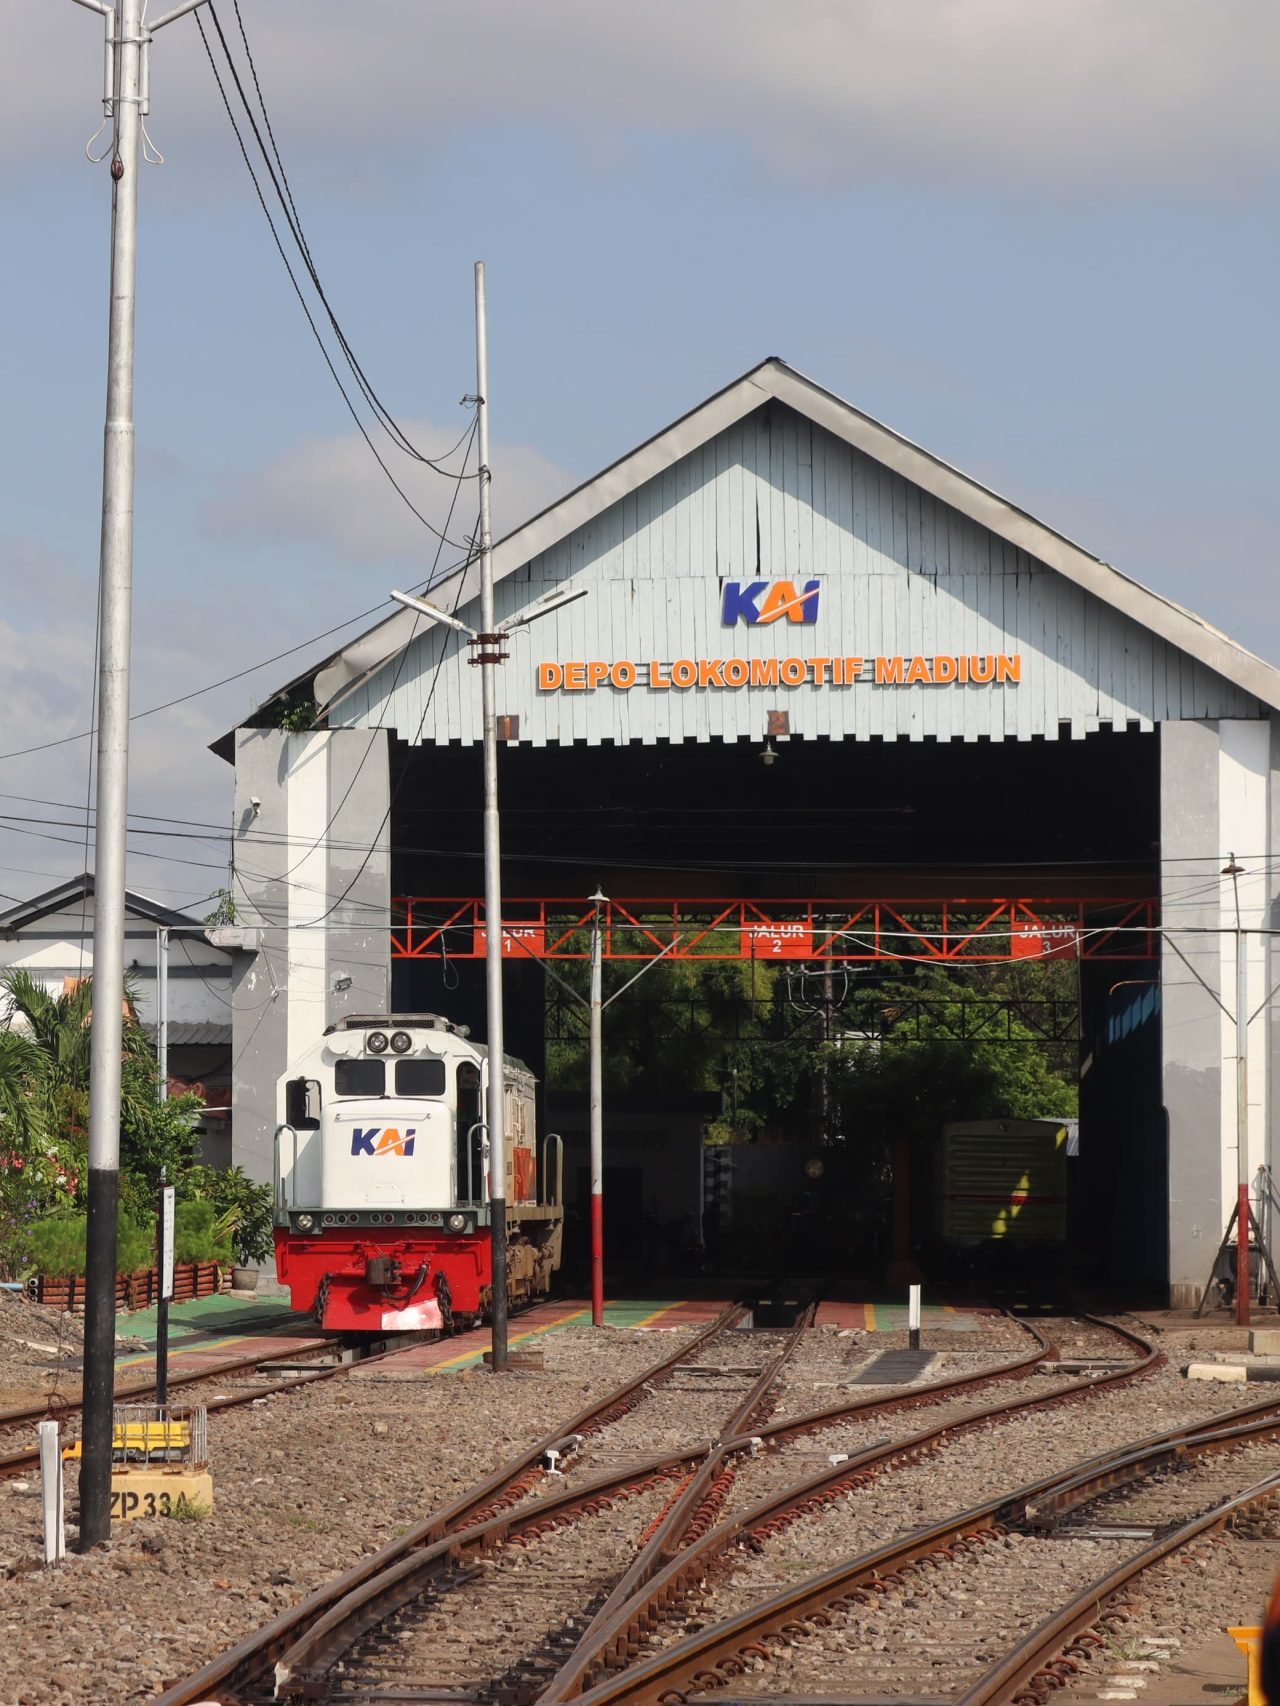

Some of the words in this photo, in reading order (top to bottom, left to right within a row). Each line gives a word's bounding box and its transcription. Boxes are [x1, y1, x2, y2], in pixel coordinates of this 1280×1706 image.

[723, 580, 820, 625] KAI
[538, 661, 637, 690] DEPO
[649, 656, 864, 689] LOKOMOTIF
[875, 654, 1021, 684] MADIUN
[749, 925, 804, 938] JALUR
[1020, 925, 1075, 938] JALUR
[504, 939, 511, 952] 1
[772, 940, 782, 953] 2
[1042, 941, 1051, 953] 3
[351, 1128, 416, 1156] KAI
[111, 1492, 139, 1518] ZP
